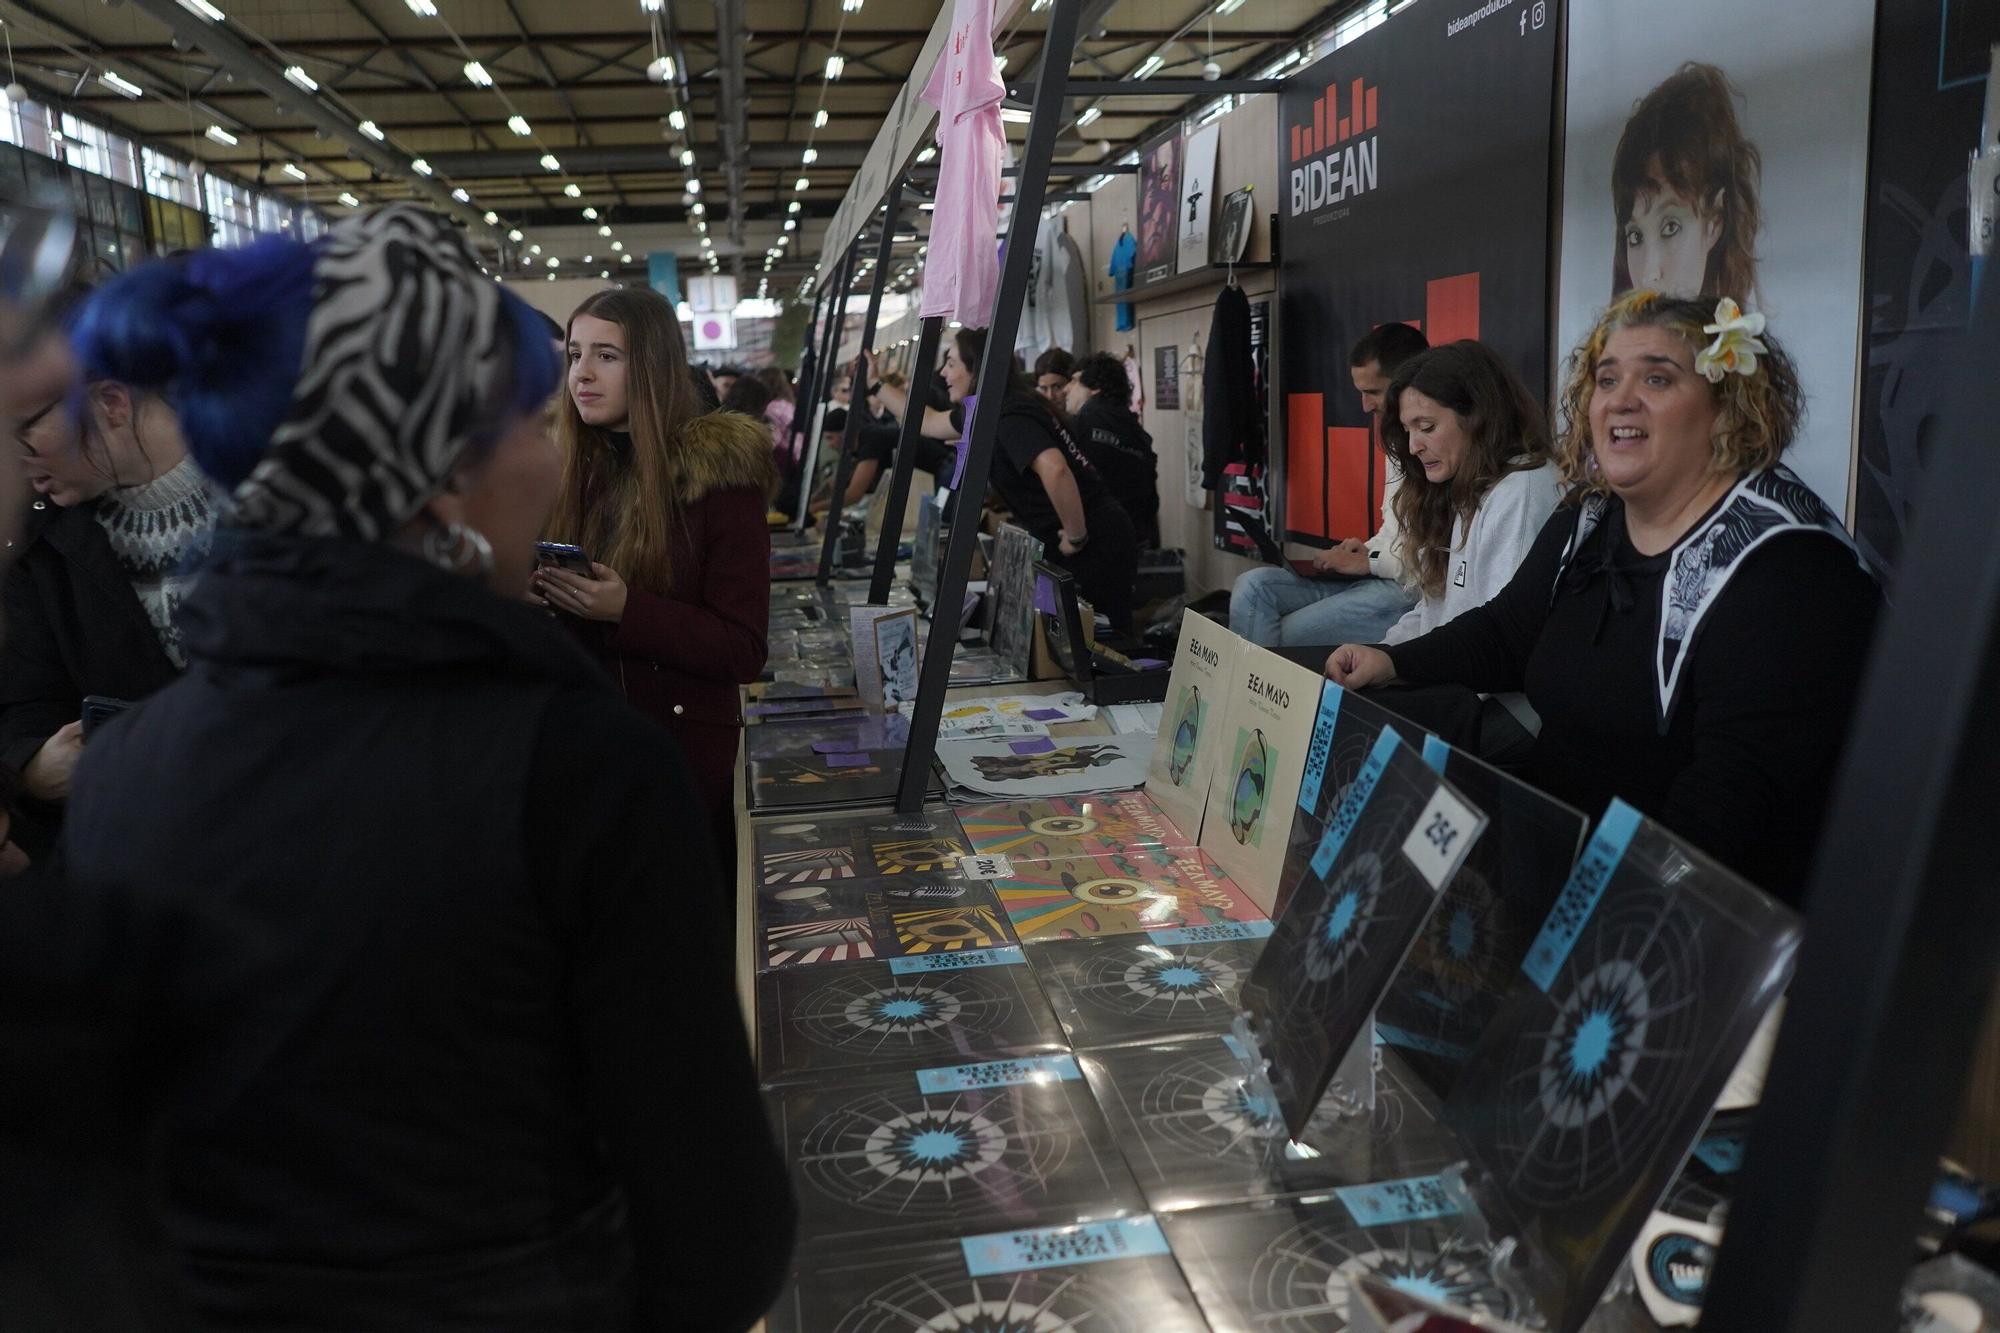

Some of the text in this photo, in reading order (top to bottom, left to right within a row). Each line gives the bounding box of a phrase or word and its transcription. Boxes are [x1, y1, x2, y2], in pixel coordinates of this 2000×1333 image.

[1291, 135, 1378, 217] BIDEAN
[1248, 673, 1290, 709] ZEA MAYS
[975, 859, 998, 876] 20€
[1174, 858, 1207, 881] ZEA
